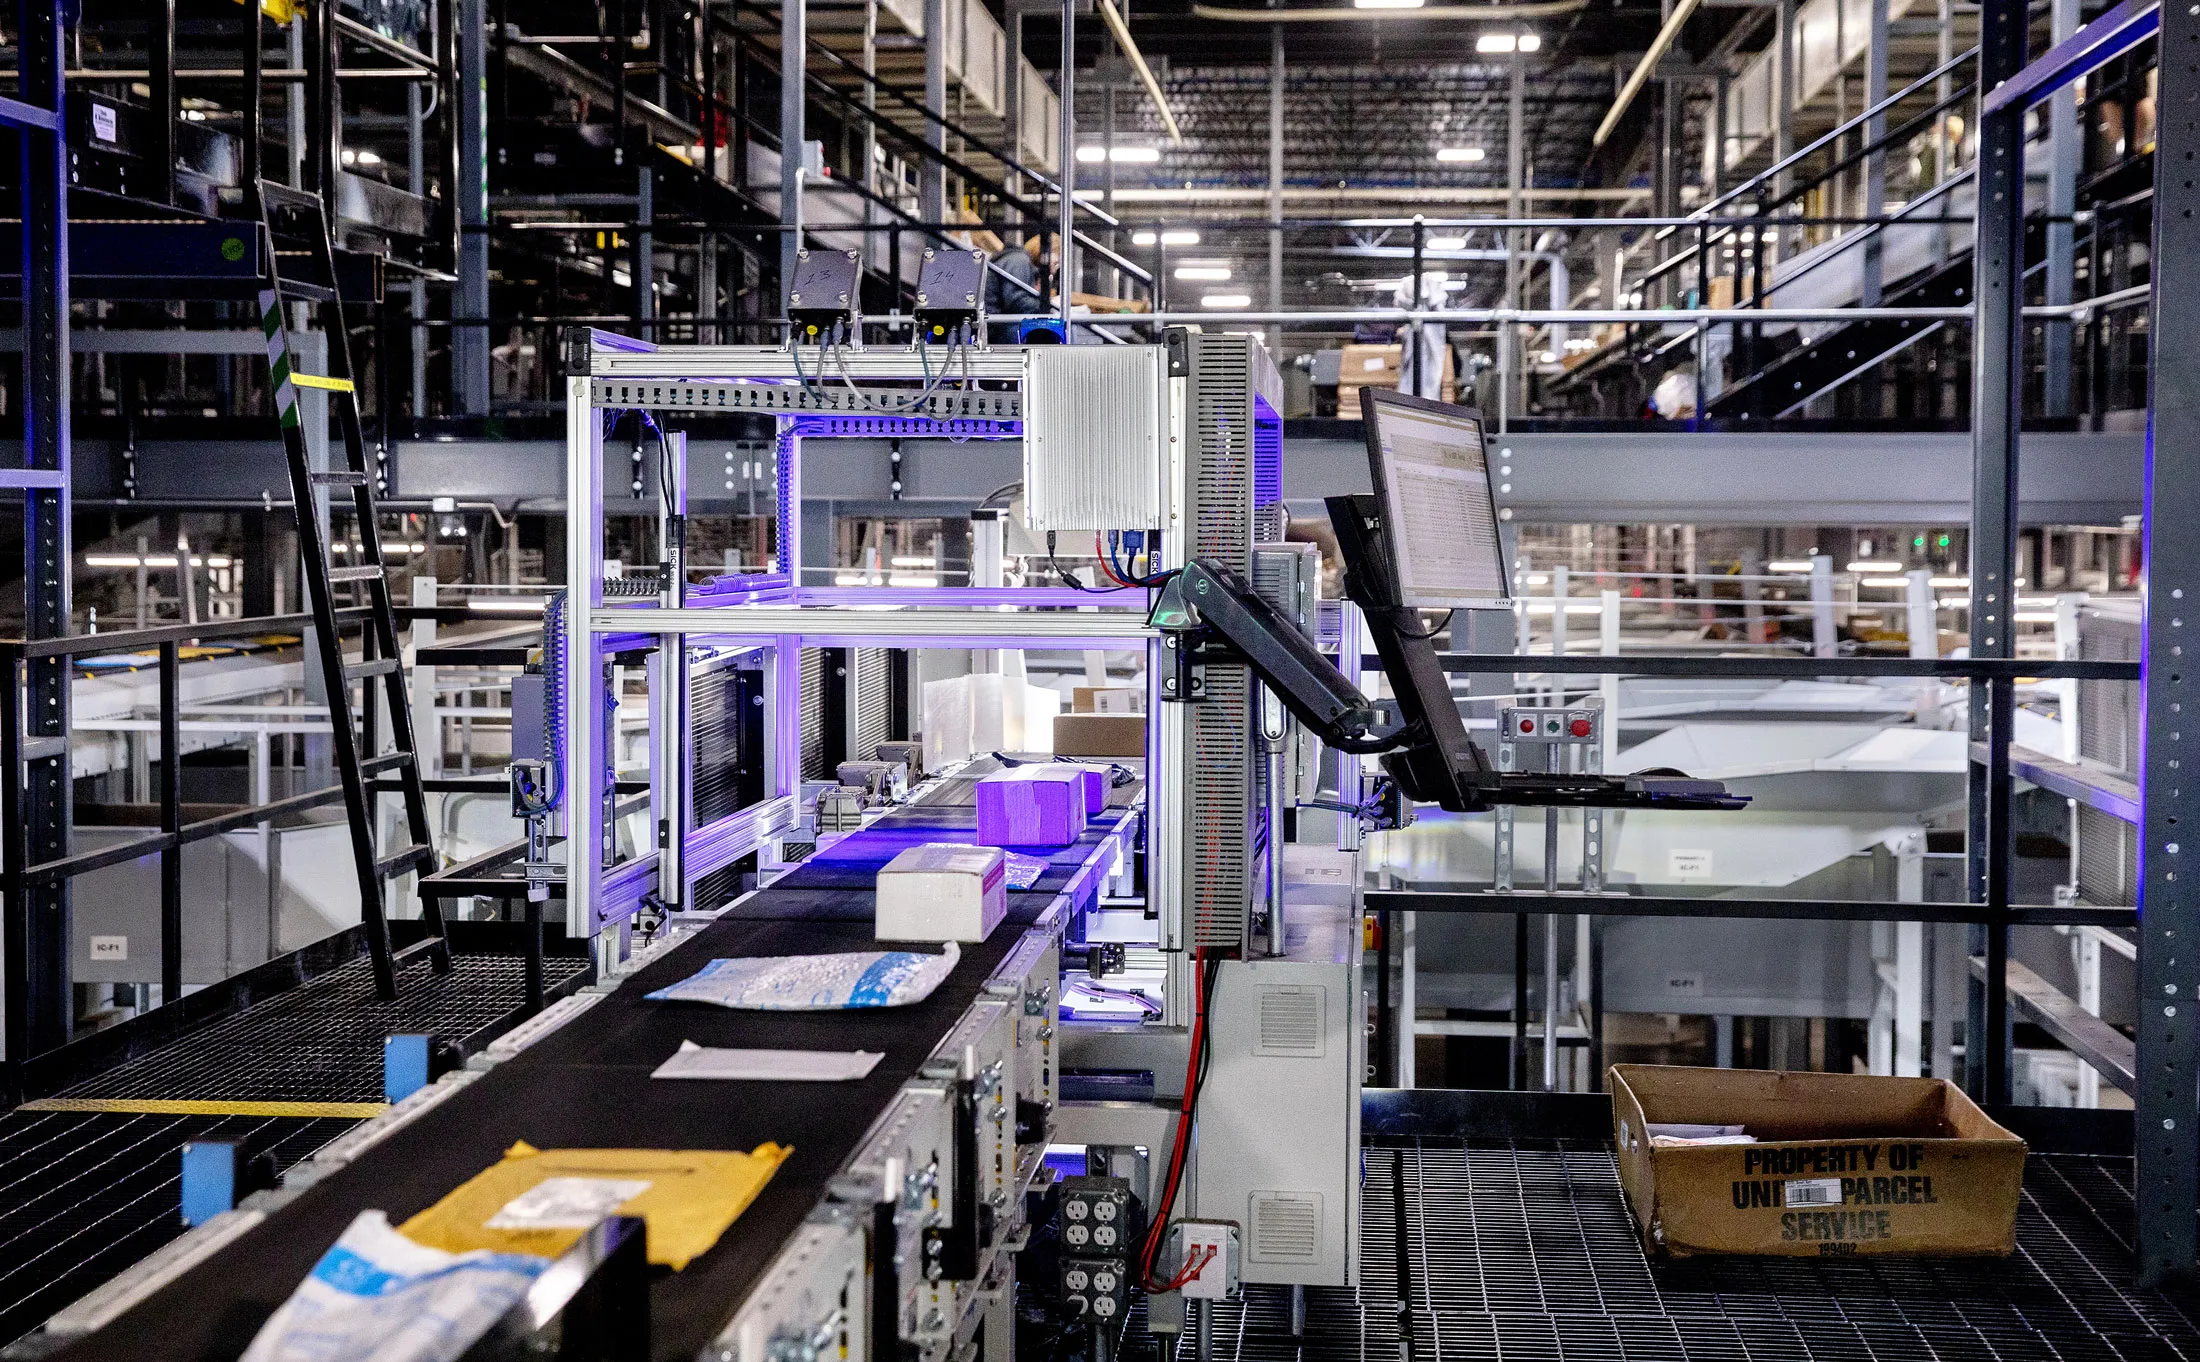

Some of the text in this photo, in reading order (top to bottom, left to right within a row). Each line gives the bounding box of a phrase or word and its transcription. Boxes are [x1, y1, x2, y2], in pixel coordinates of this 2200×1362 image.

[803, 270, 832, 287] 13
[930, 271, 955, 286] 14
[1745, 1143, 1924, 1175] PROPERTY OF
[1732, 1175, 1938, 1209] UNI PARCEL
[1781, 1209, 1891, 1241] SERVICE
